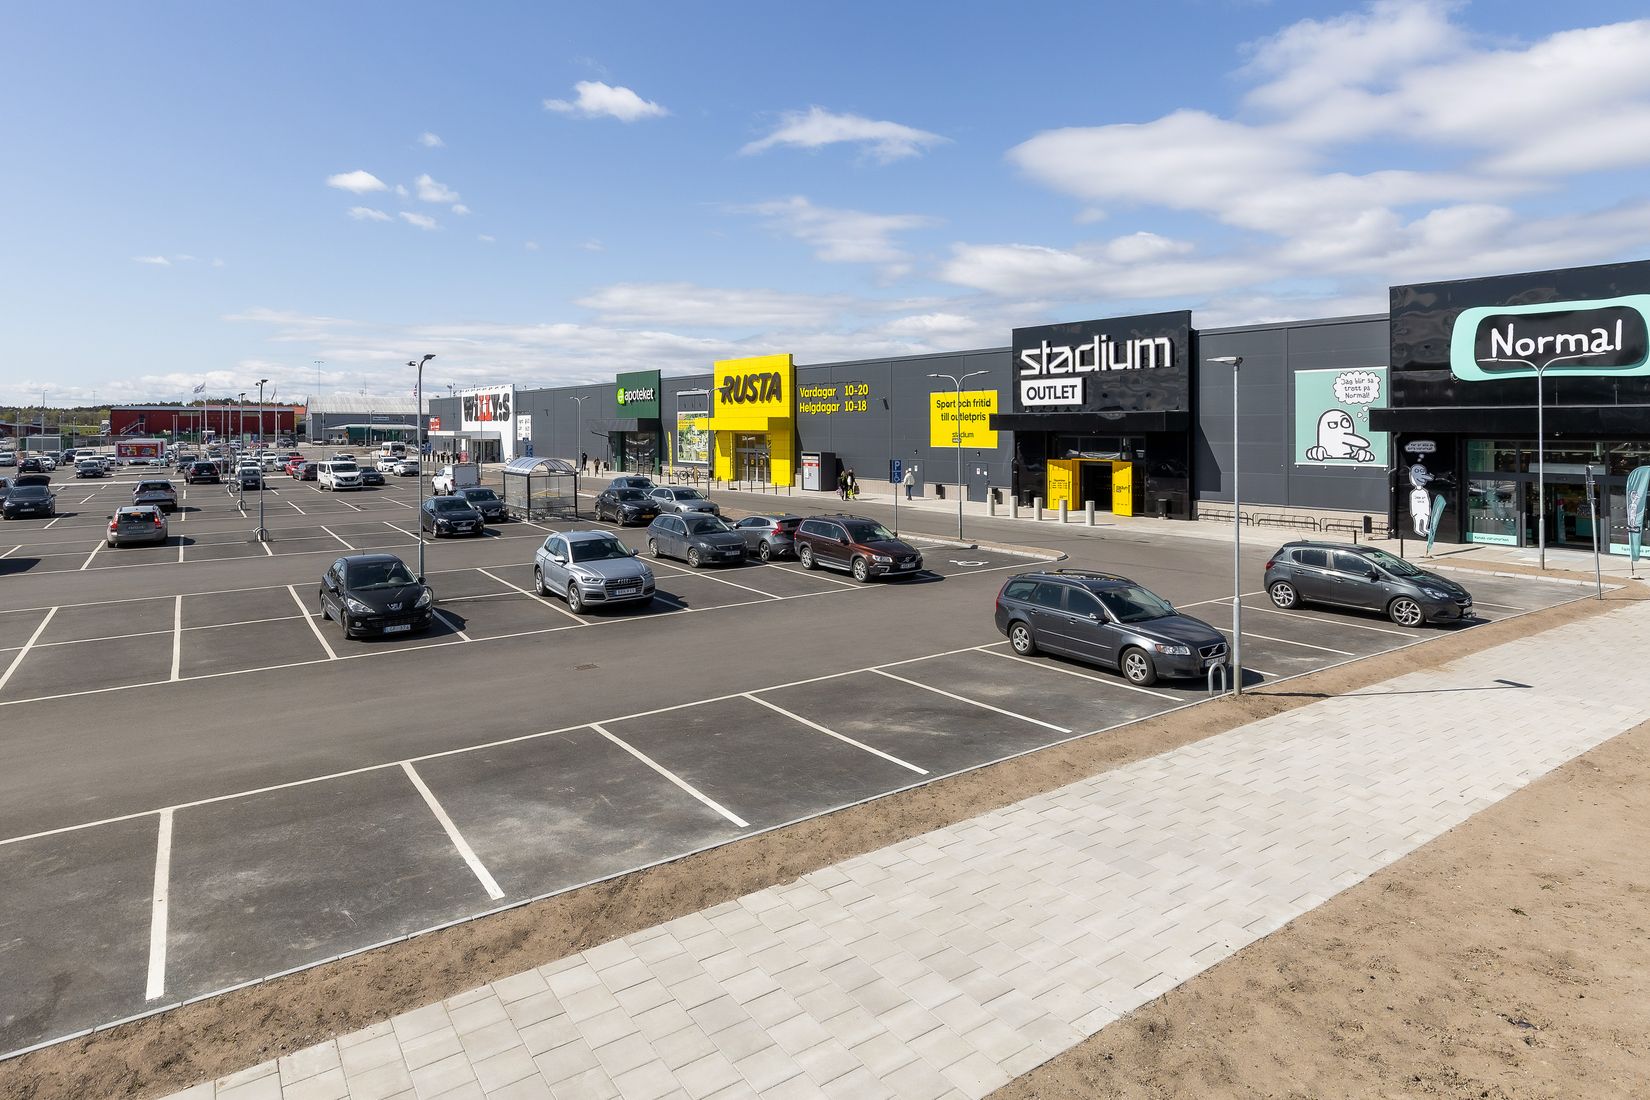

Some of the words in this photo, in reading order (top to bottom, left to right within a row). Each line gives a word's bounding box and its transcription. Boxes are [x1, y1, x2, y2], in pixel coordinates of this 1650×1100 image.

[1491, 319, 1622, 357] Normal
[1020, 334, 1171, 376] stadium
[624, 387, 655, 403] apoteket
[719, 372, 782, 404] RUSTA
[799, 386, 837, 399] Vardagar
[844, 383, 869, 396] 10-20
[1026, 384, 1078, 401] OUTLET
[799, 401, 841, 415] Helgdagar
[844, 399, 867, 412] 10-18
[936, 399, 956, 410] Sport
[973, 398, 991, 408] fritid
[941, 413, 950, 421] till
[894, 460, 900, 470] P
